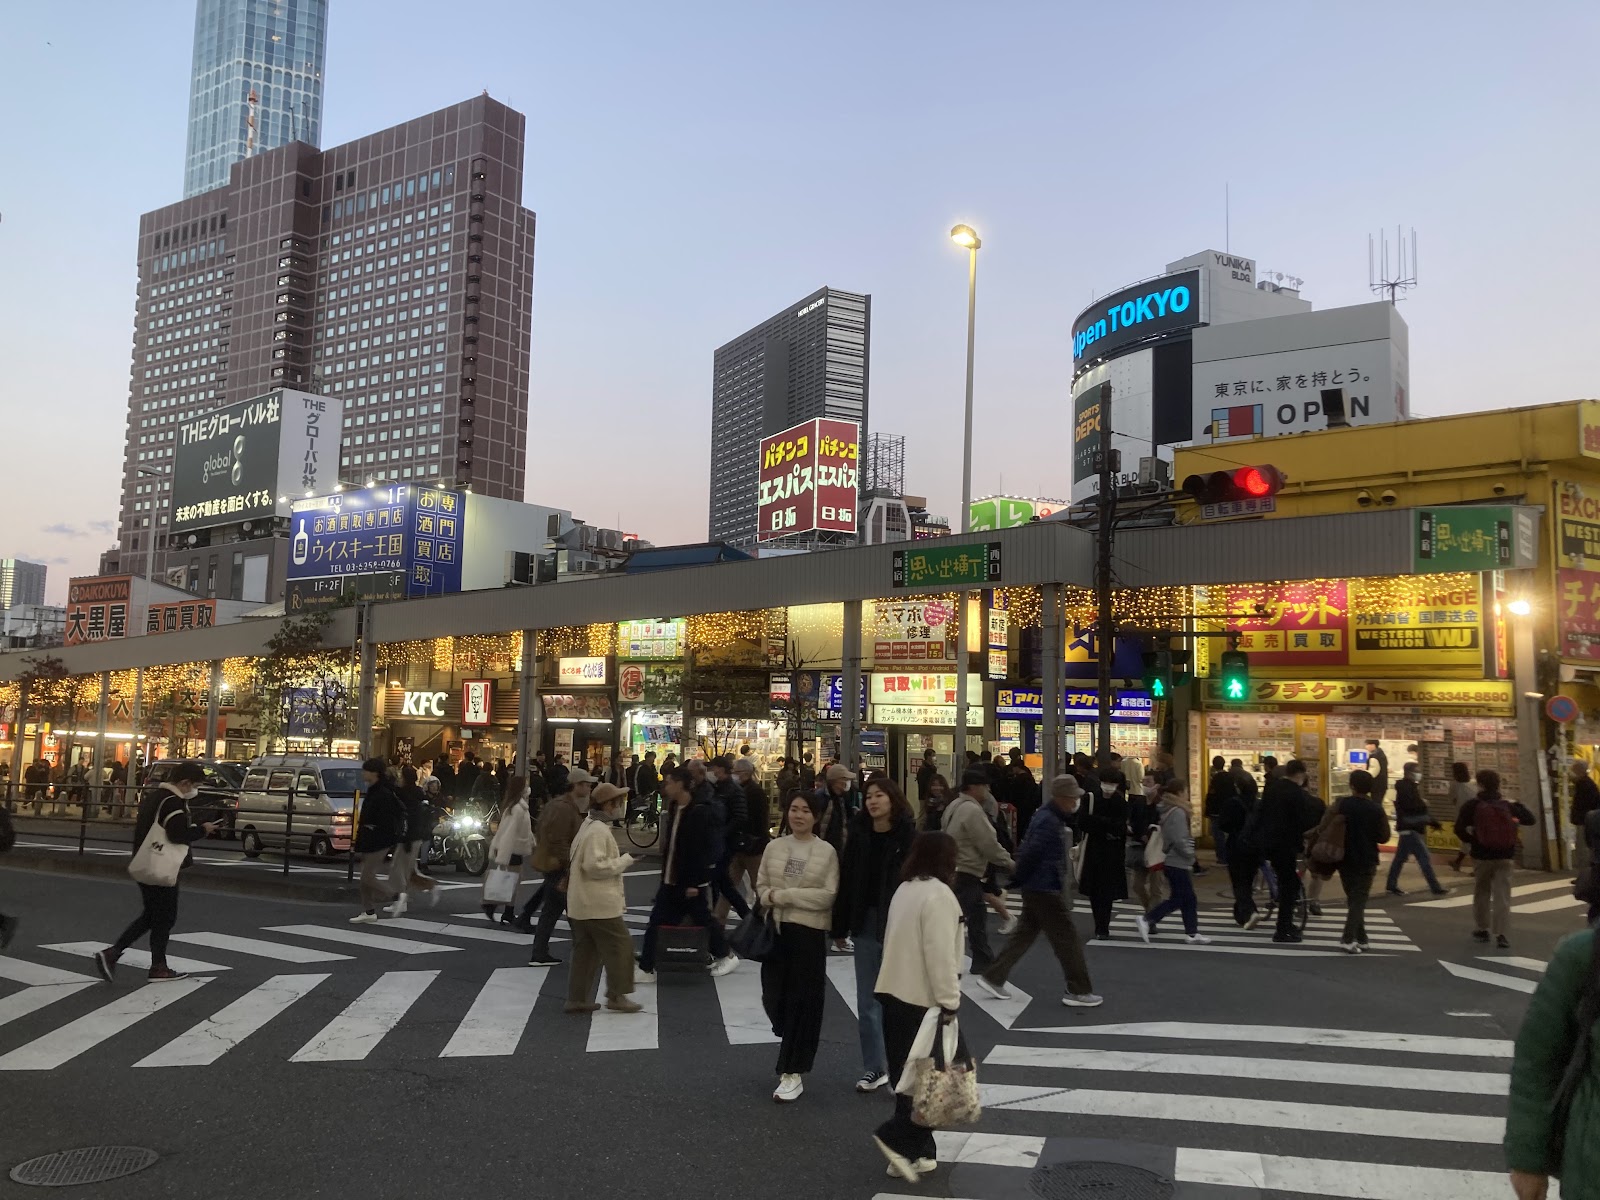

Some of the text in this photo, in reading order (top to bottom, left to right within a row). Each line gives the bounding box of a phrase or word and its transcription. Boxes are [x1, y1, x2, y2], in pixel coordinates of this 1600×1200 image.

[1213, 253, 1252, 273] YUNIKA
[1108, 285, 1190, 333] TOKYO
[1214, 367, 1371, 399] 東京に、家を持とう。
[181, 396, 280, 446] THEグローバル社
[1078, 403, 1100, 423] SPORTS
[1276, 395, 1370, 425] OPN
[764, 435, 809, 470] パチンコ
[819, 435, 858, 460] パチンコ
[202, 449, 232, 484] global
[817, 463, 858, 490] エスパス
[1121, 471, 1140, 485] BLD
[386, 486, 406, 505] 1F
[759, 463, 814, 507] エスパス
[175, 489, 273, 523] 未来の不動産を面白くする。
[771, 505, 797, 531] 日拓
[821, 506, 852, 523] 日拓
[1204, 497, 1273, 517] 自転車専用
[314, 508, 402, 534] お酒買取専門店
[312, 533, 404, 563] ウイスキー王国
[1437, 523, 1494, 556] 思い出横丁
[330, 564, 343, 573] TEL
[909, 554, 982, 582] 思い出横丁
[78, 582, 128, 600] DAIKOKUYA
[67, 602, 127, 642] 大黒屋
[147, 603, 213, 634] 高価買取
[877, 605, 923, 624] スマホ
[1231, 594, 1342, 627] チケット
[1418, 609, 1478, 624] 国際送金
[906, 625, 931, 640] 修理
[1238, 632, 1336, 648] 販売 買取
[1358, 629, 1425, 640] WESTERN
[1379, 638, 1425, 648] UNION
[401, 691, 446, 716] KFC
